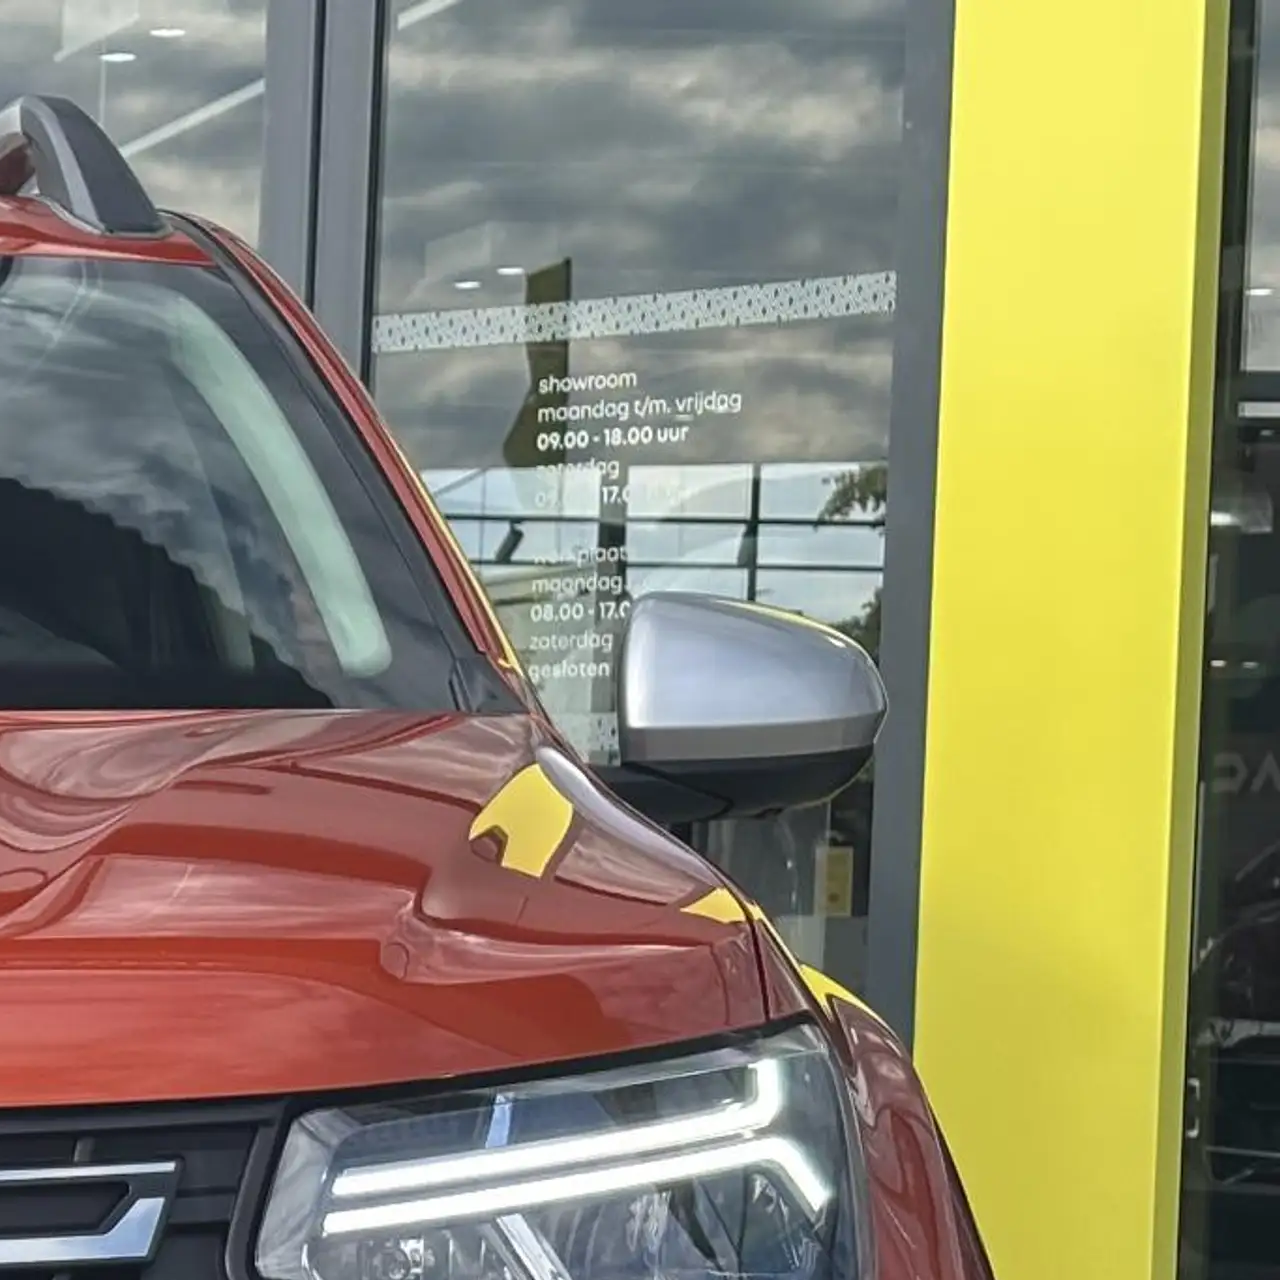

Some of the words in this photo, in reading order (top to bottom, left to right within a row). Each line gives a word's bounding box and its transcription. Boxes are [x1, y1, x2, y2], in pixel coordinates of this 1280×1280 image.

[538, 371, 638, 395] showroom
[537, 398, 629, 423] maandag
[634, 394, 671, 419] t/m.
[675, 389, 743, 415] vrijdag
[536, 429, 590, 452] 09.00
[602, 425, 653, 447] 18.00
[656, 425, 691, 443] uur
[530, 602, 585, 623] 08.00
[529, 630, 615, 654] zaterdag
[527, 659, 611, 684] gesloten
